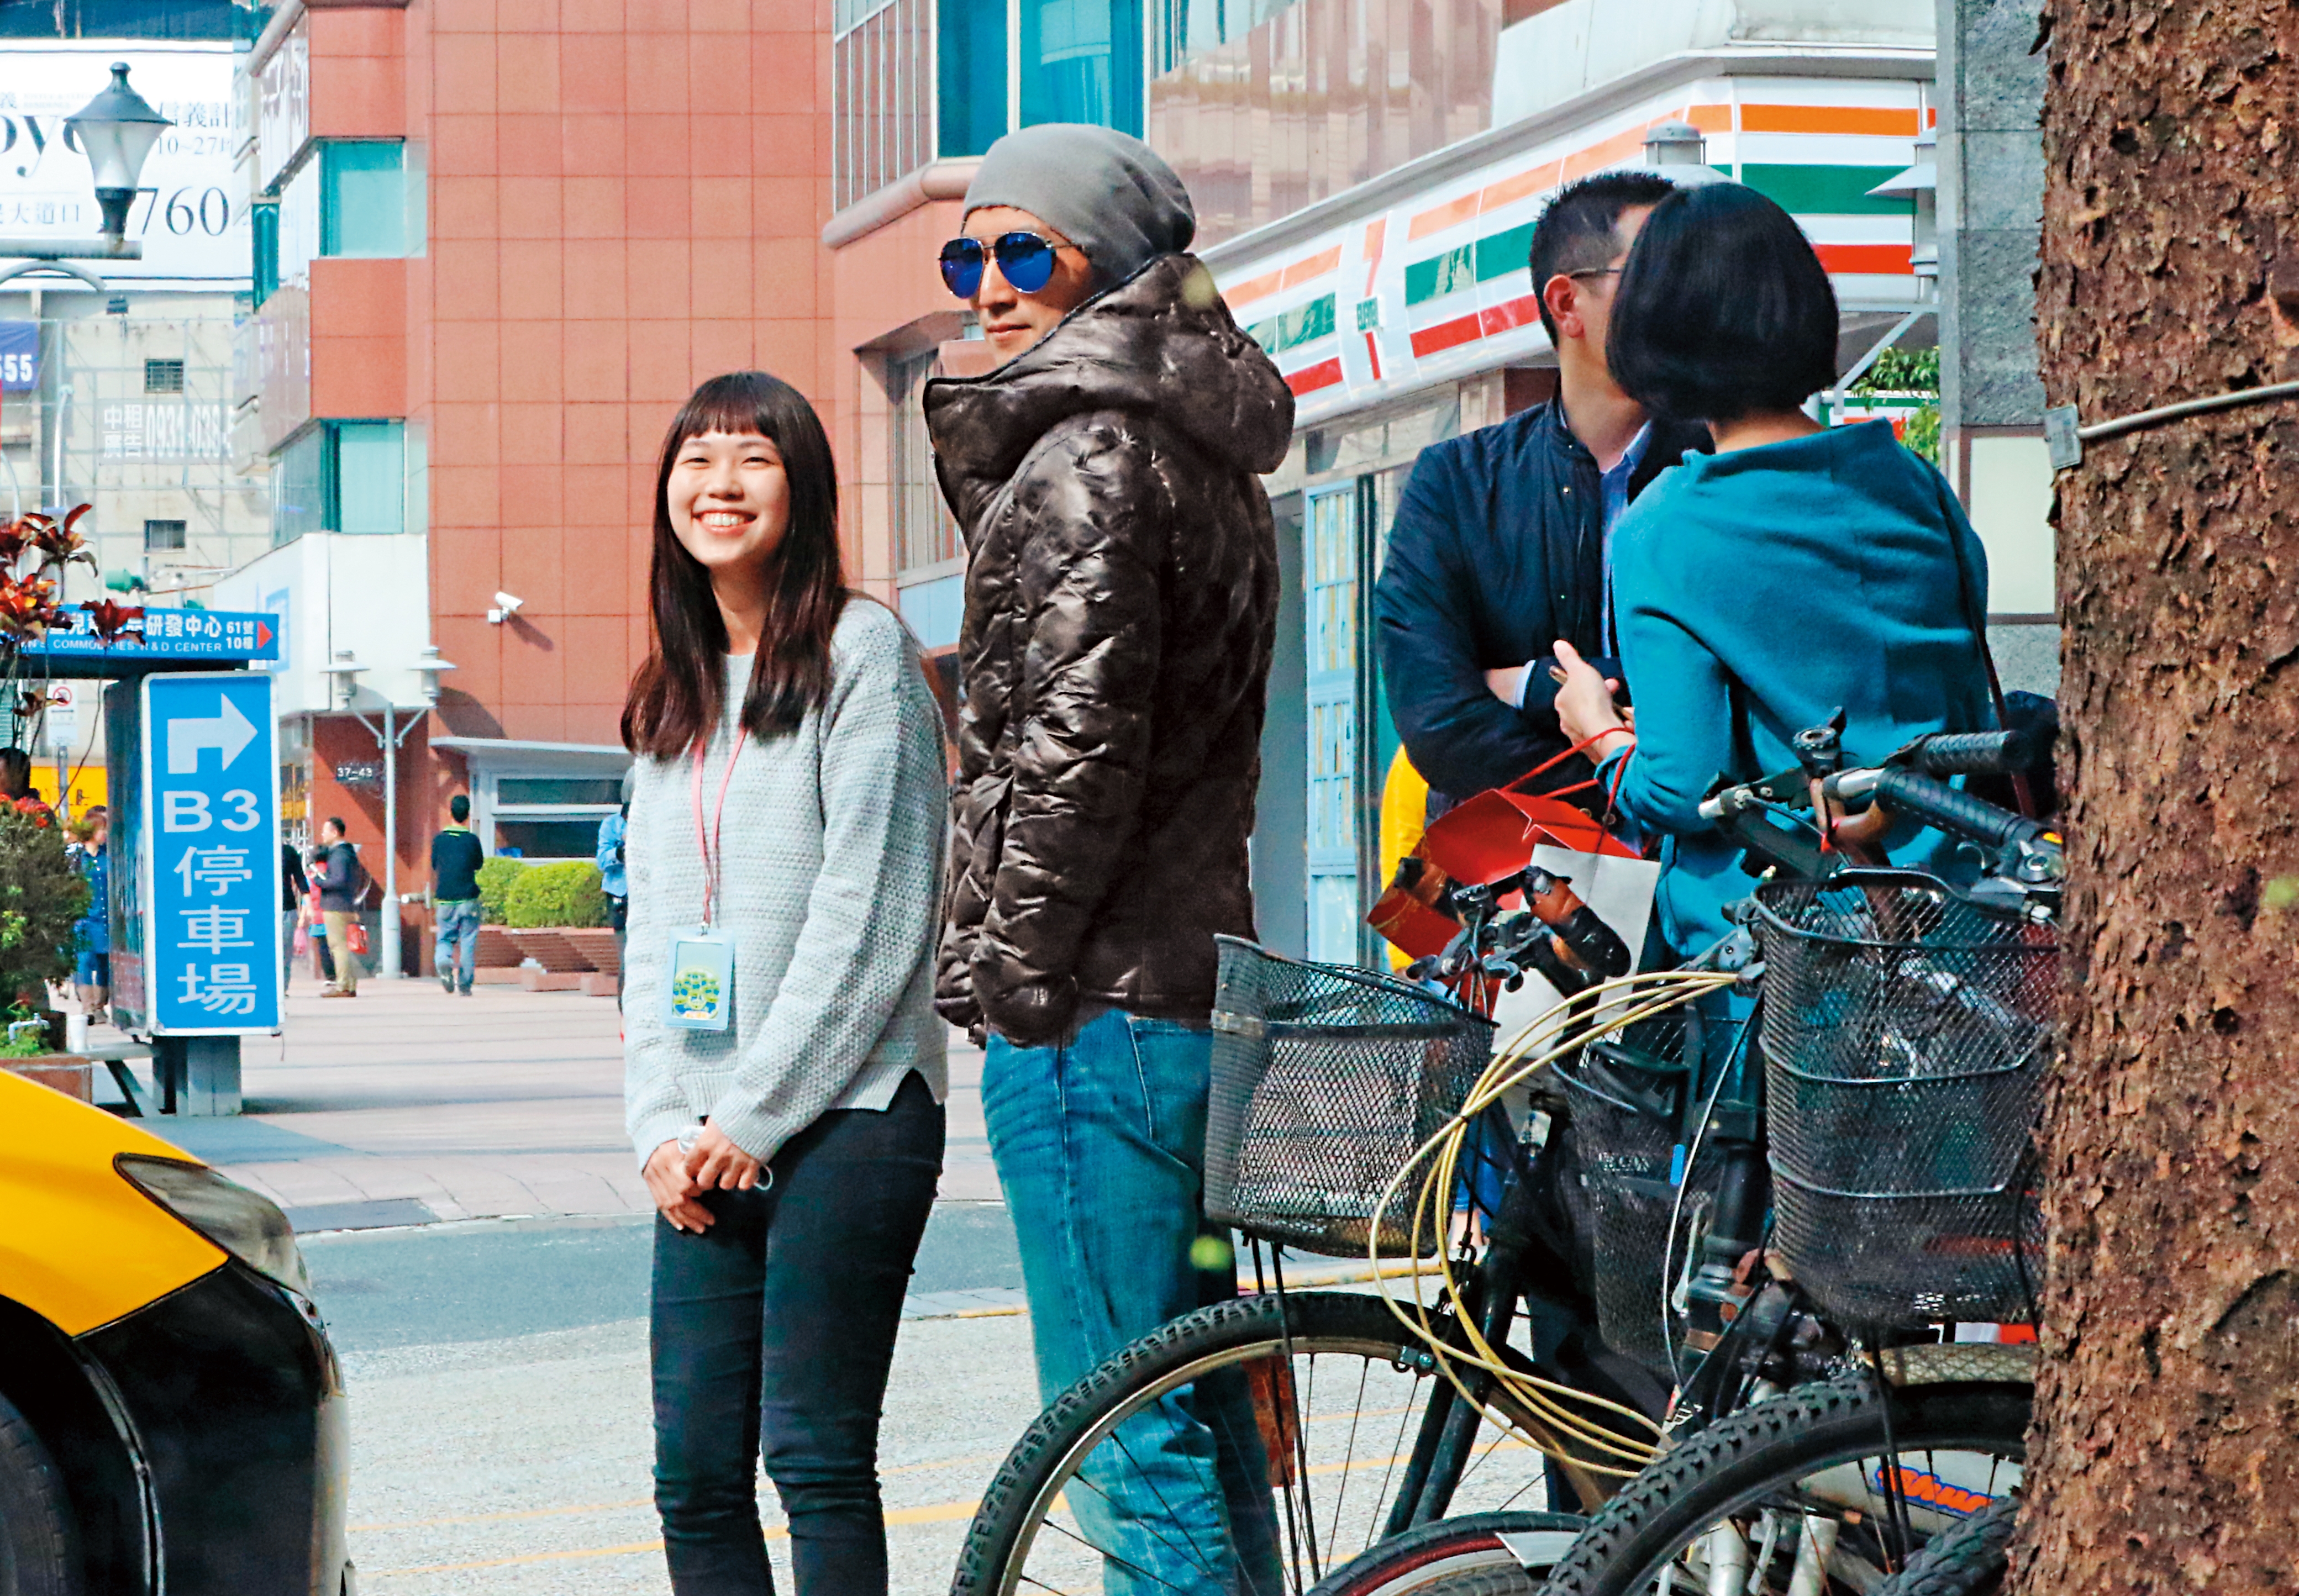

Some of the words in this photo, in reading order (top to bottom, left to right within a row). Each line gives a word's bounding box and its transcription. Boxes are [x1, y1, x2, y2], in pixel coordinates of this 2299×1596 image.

[0, 203, 78, 224] 大道口
[0, 354, 33, 383] 55
[175, 642, 222, 652] CENTER
[164, 789, 261, 833] B3
[173, 844, 257, 1015] 停車場
